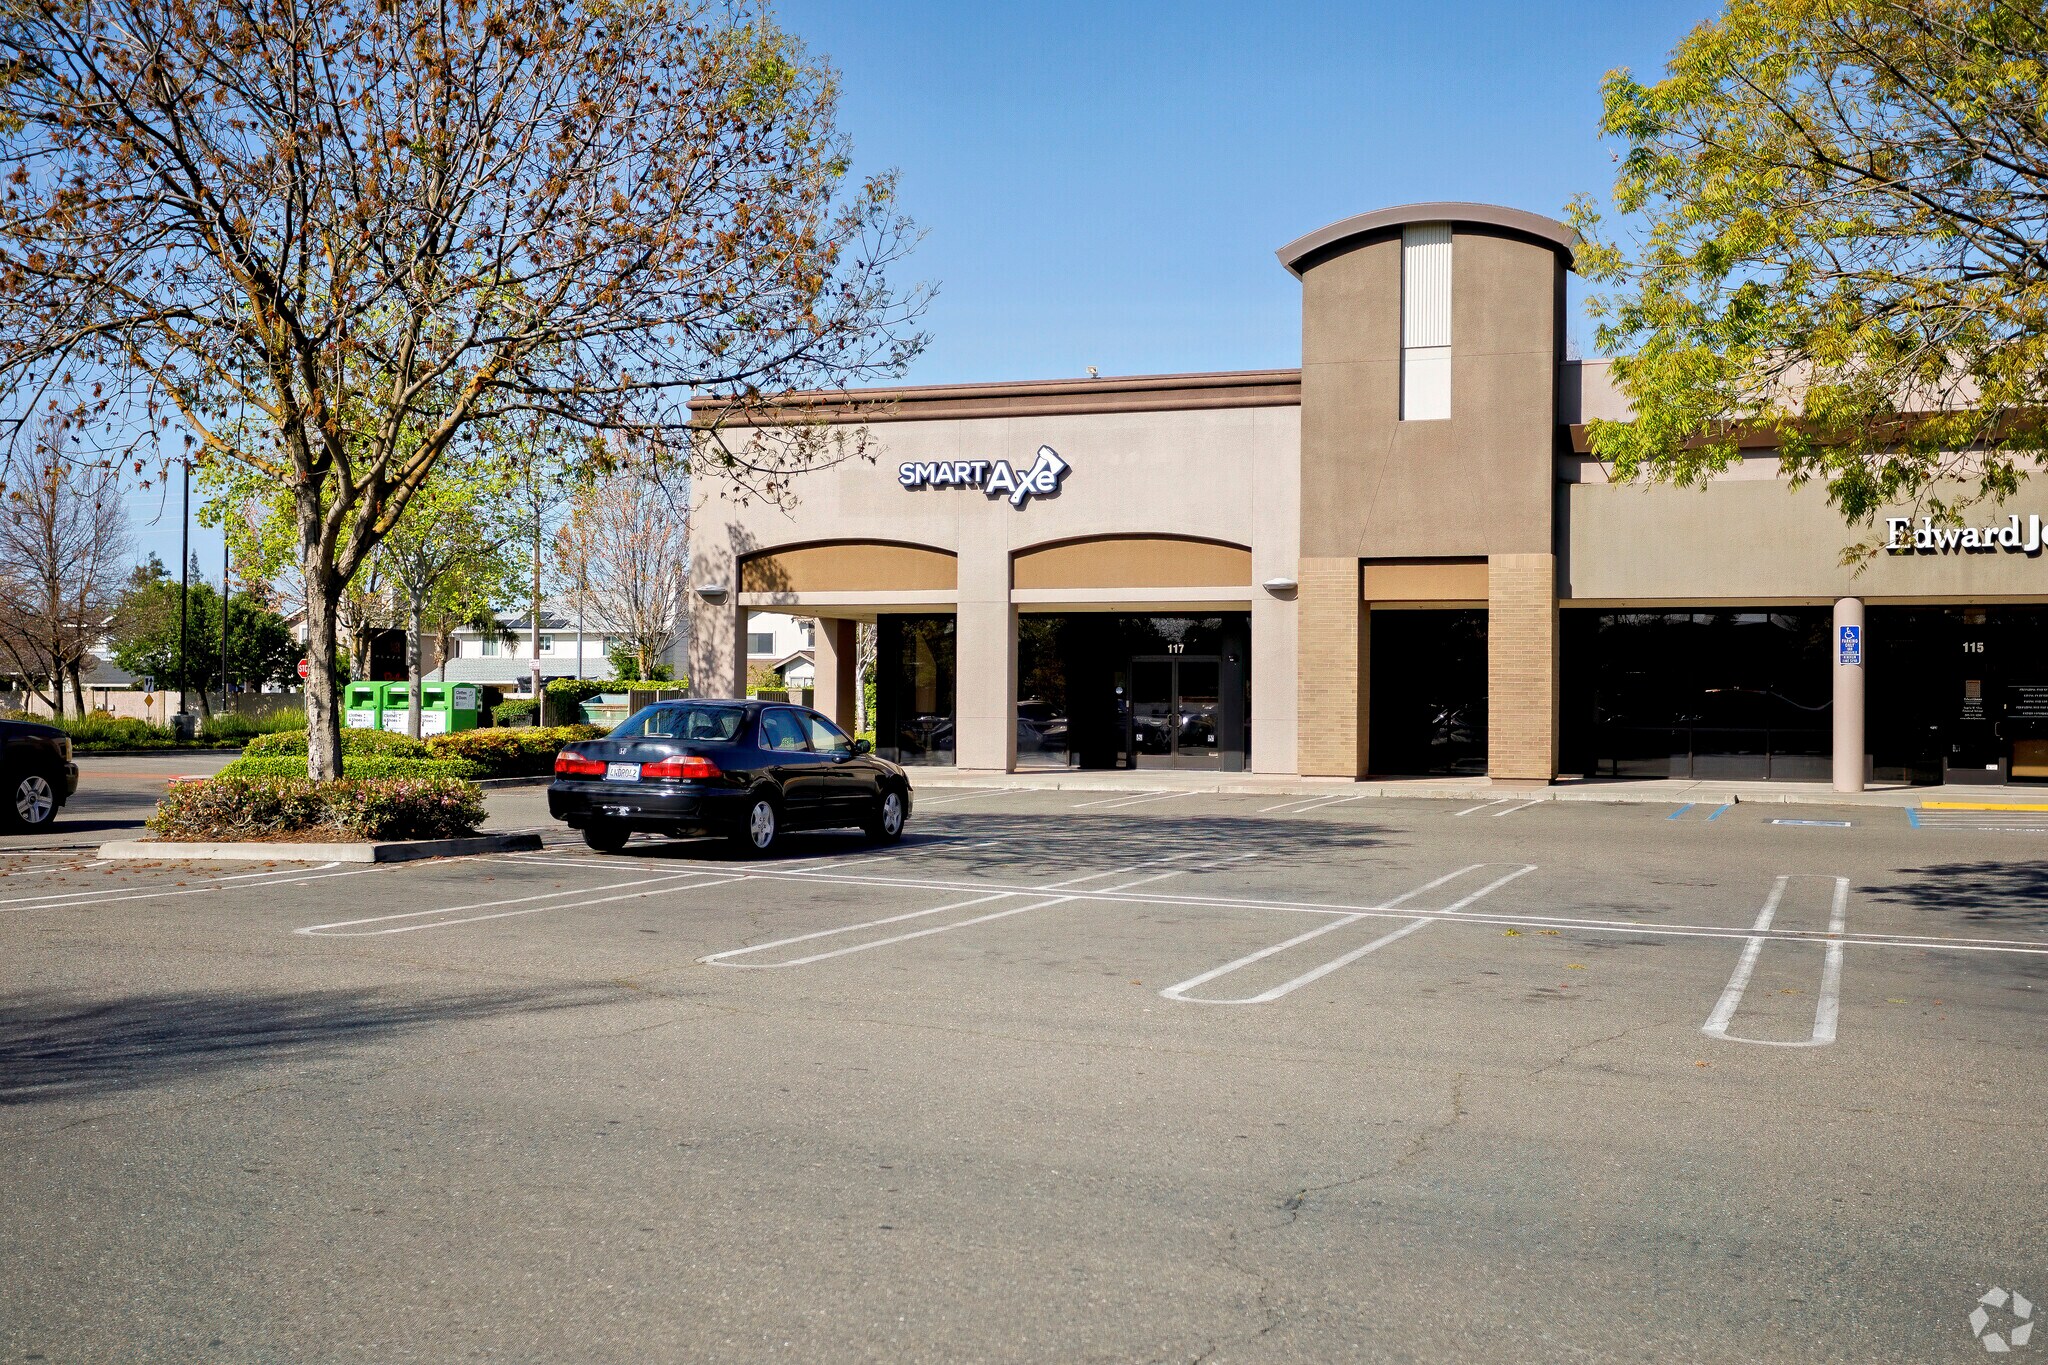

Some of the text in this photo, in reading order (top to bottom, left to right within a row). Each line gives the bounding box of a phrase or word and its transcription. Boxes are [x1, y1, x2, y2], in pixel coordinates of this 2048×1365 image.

[899, 461, 986, 485] SMART
[1167, 644, 1184, 653] 117
[1962, 641, 1984, 653] 115
